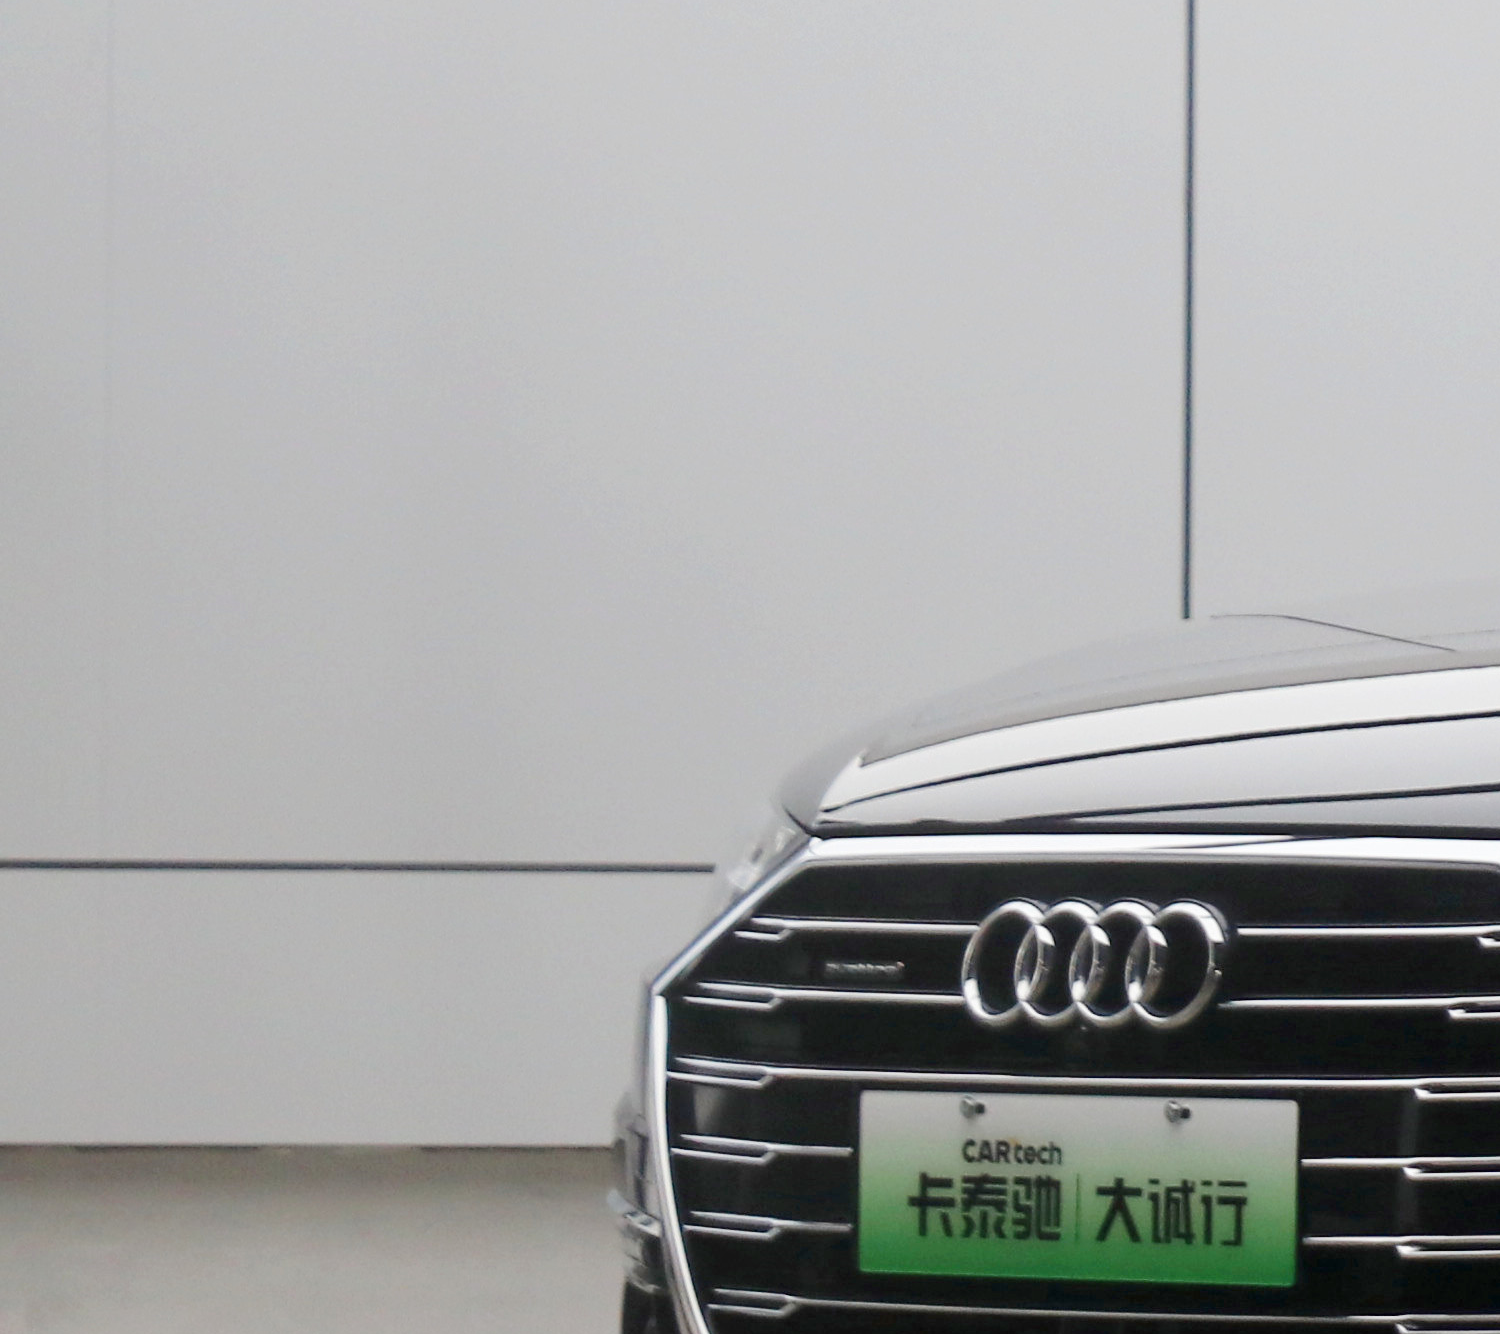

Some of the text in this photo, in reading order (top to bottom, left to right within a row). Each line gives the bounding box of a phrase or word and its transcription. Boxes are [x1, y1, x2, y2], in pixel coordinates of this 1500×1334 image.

[961, 1139, 1063, 1165] CARtech
[907, 1172, 1248, 1246] 卡泰驰 大诚行
